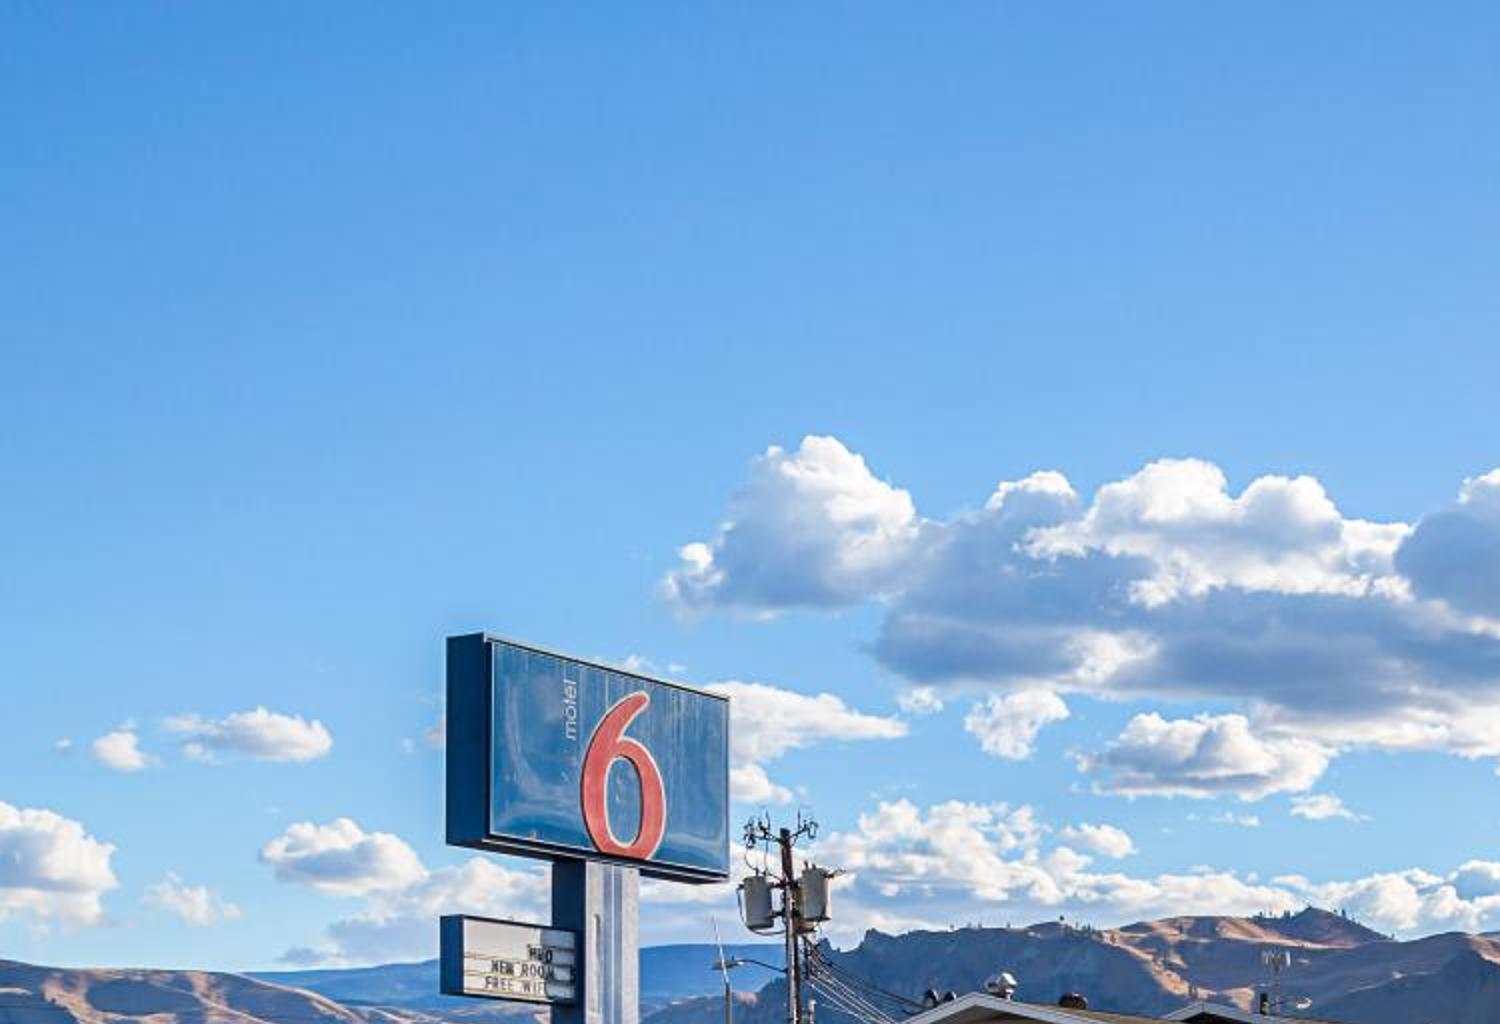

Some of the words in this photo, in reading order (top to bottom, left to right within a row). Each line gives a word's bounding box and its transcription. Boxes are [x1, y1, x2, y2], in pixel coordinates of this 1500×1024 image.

[563, 679, 577, 741] motel
[580, 690, 667, 861] 6
[484, 976, 512, 994] FREE
[521, 980, 546, 996] WIF
[491, 959, 514, 974] NEW
